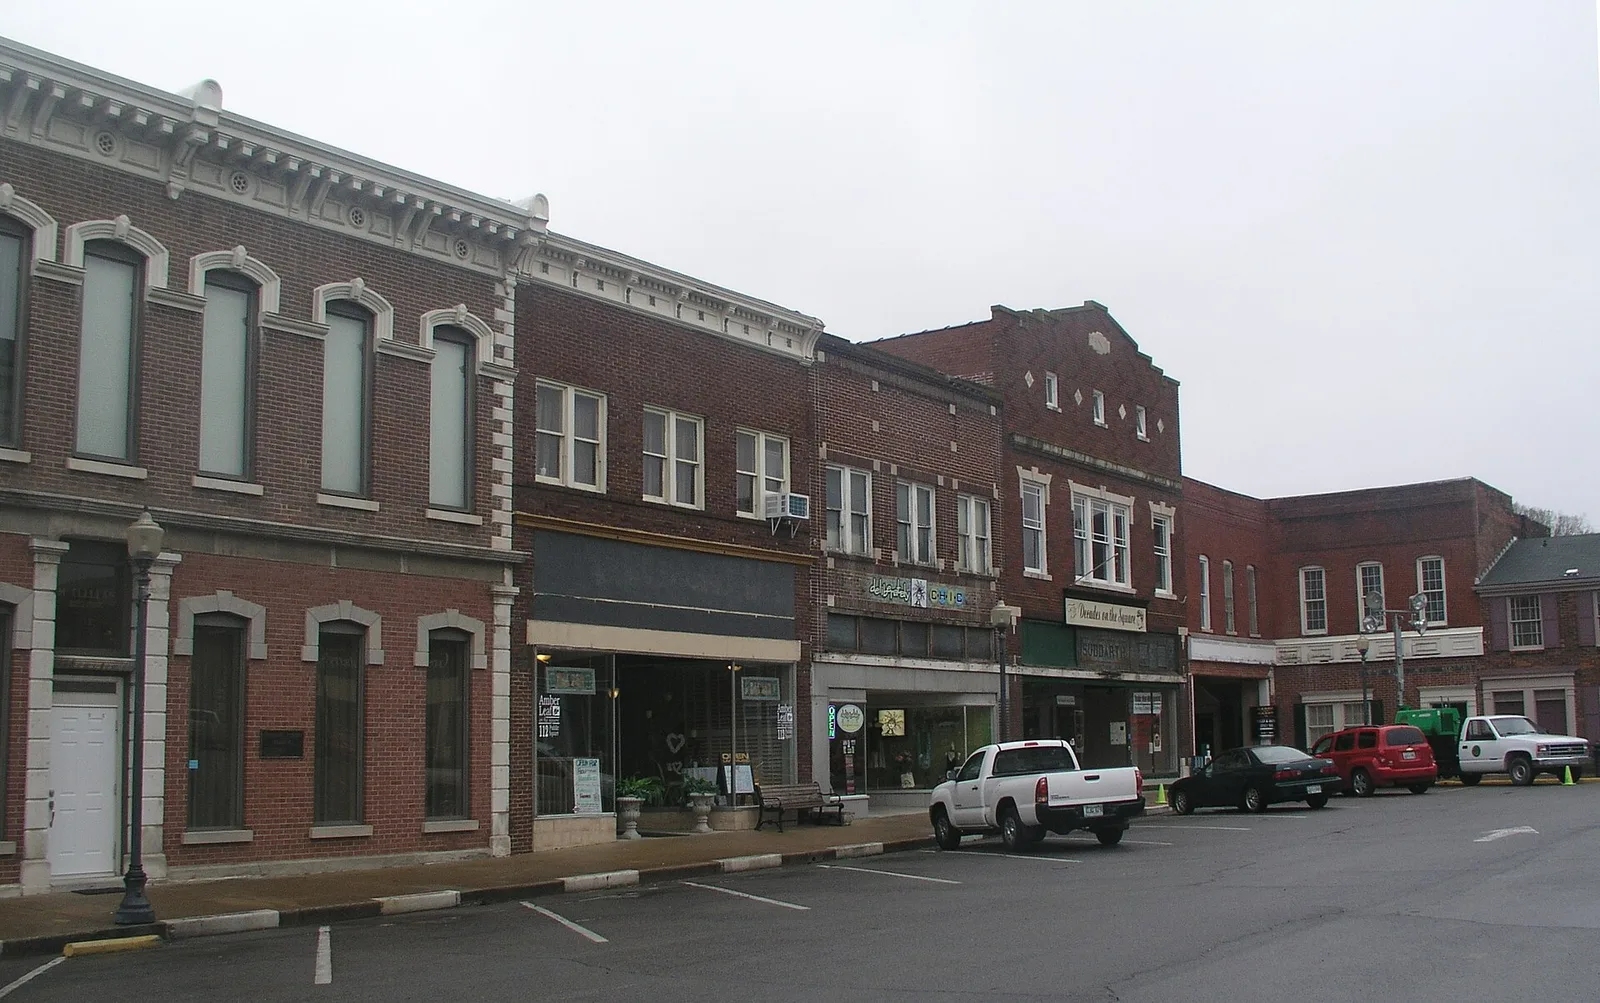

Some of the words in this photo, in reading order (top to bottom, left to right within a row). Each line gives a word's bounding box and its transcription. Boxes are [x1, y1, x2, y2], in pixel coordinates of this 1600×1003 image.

[1079, 602, 1101, 621] Decades
[1102, 611, 1109, 621] on
[1109, 606, 1117, 622] the
[1117, 607, 1136, 626] Square
[538, 694, 560, 706] Amber
[539, 704, 553, 717] Leaf
[828, 706, 836, 737] OPEN
[539, 725, 549, 737] 112
